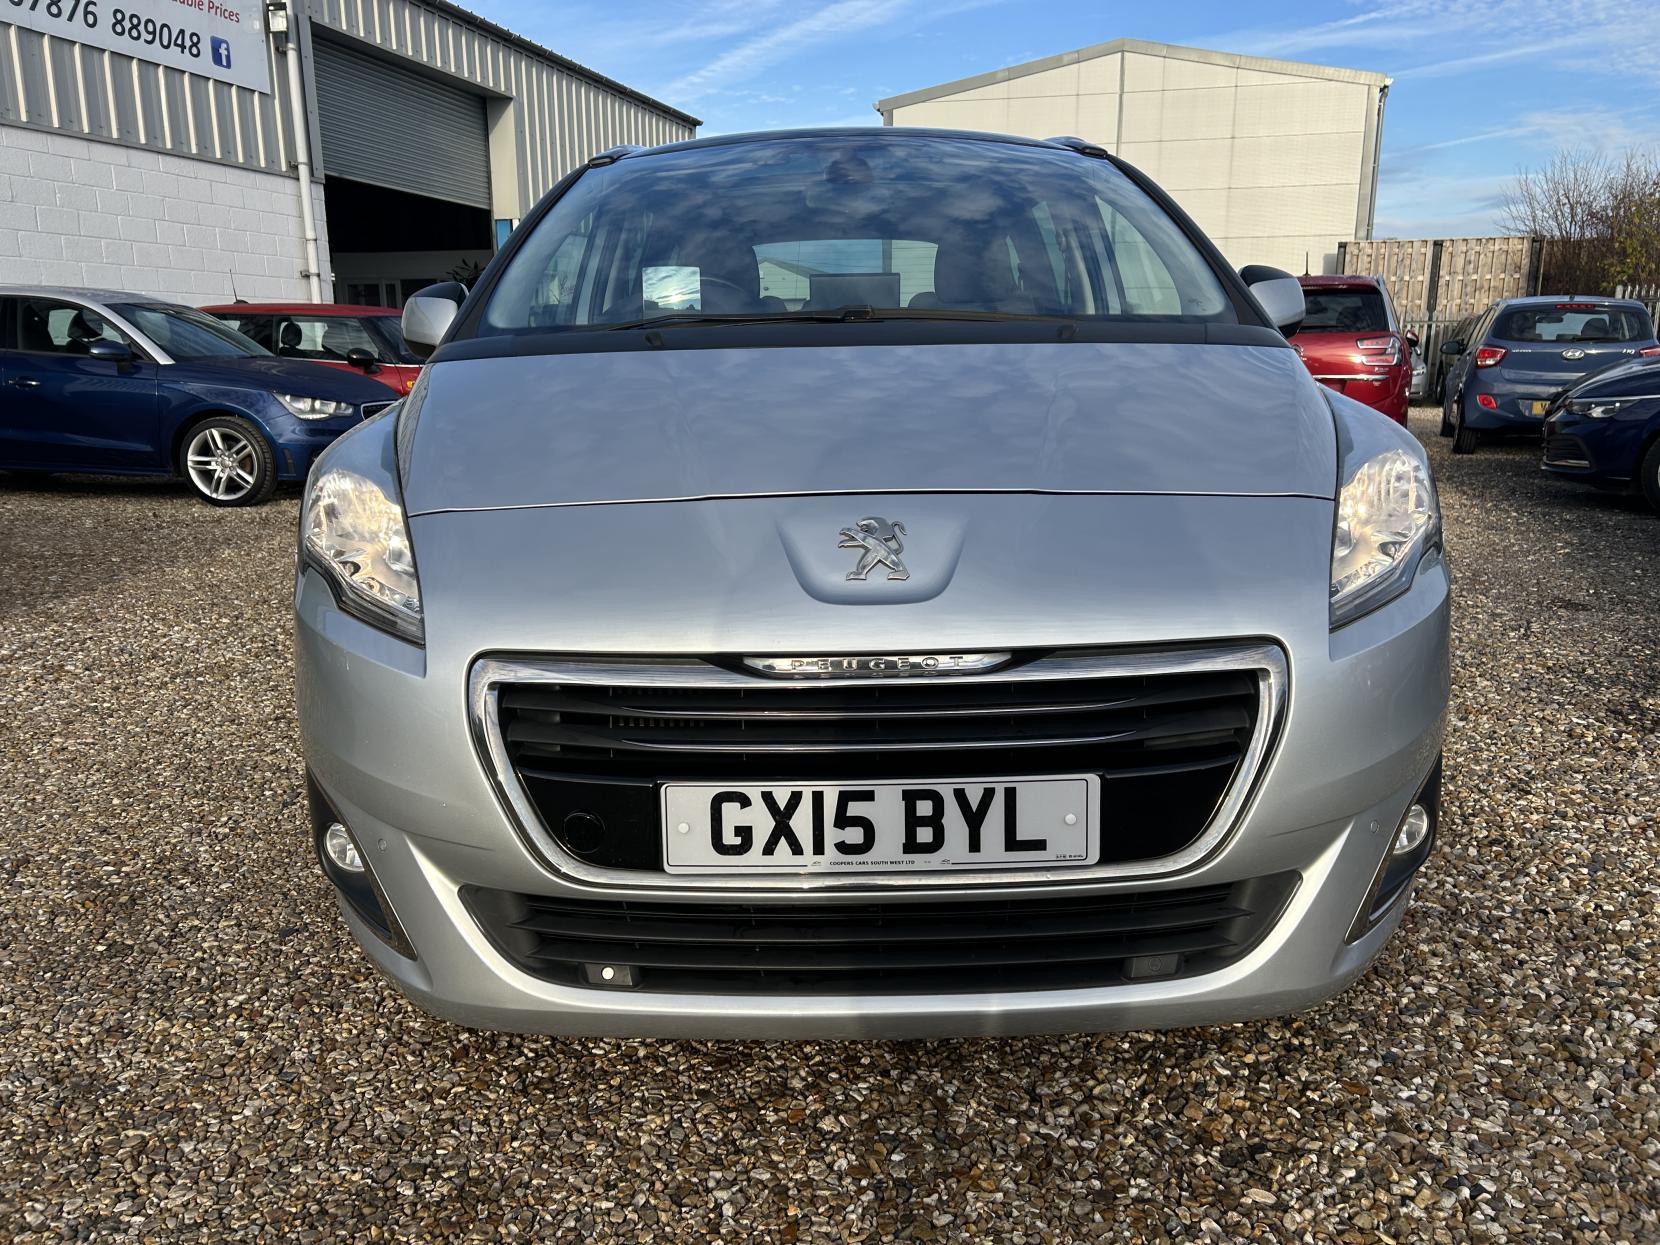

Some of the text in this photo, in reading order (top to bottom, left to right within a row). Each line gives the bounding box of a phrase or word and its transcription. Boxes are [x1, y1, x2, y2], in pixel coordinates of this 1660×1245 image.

[8, 0, 201, 58] 876 889048
[207, 0, 240, 23] Prices
[791, 655, 964, 672] PEUGEOT
[709, 786, 1048, 857] GX15 BYL
